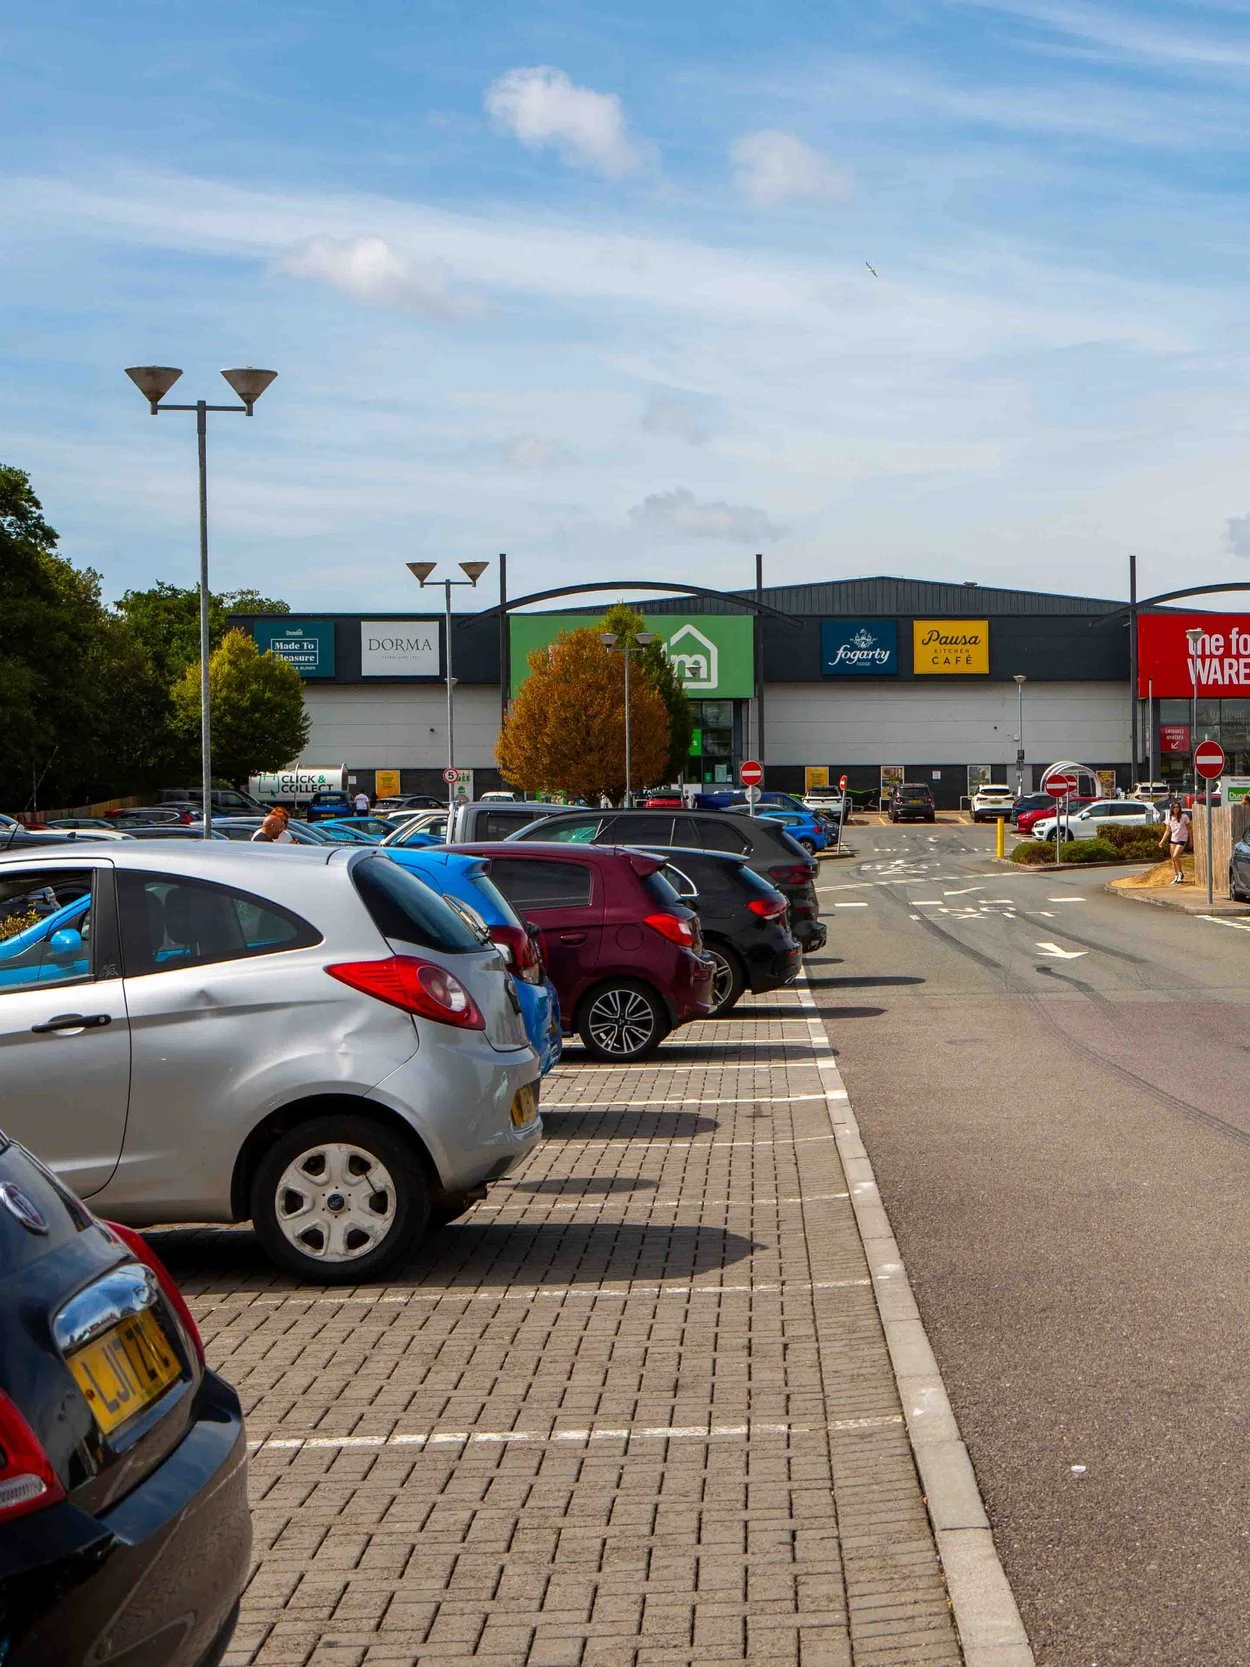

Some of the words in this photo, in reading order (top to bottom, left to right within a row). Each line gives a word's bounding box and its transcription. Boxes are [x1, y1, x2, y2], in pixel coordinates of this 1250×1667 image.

[922, 629, 981, 646] Pausa
[274, 642, 300, 650] Made
[302, 642, 315, 650] To
[368, 638, 432, 652] DORMA
[828, 644, 891, 666] fogarty
[931, 654, 973, 665] CAFÉ
[281, 775, 315, 784] CLICK
[317, 775, 327, 784] &
[447, 771, 454, 780] 5
[281, 783, 334, 793] COLLECT
